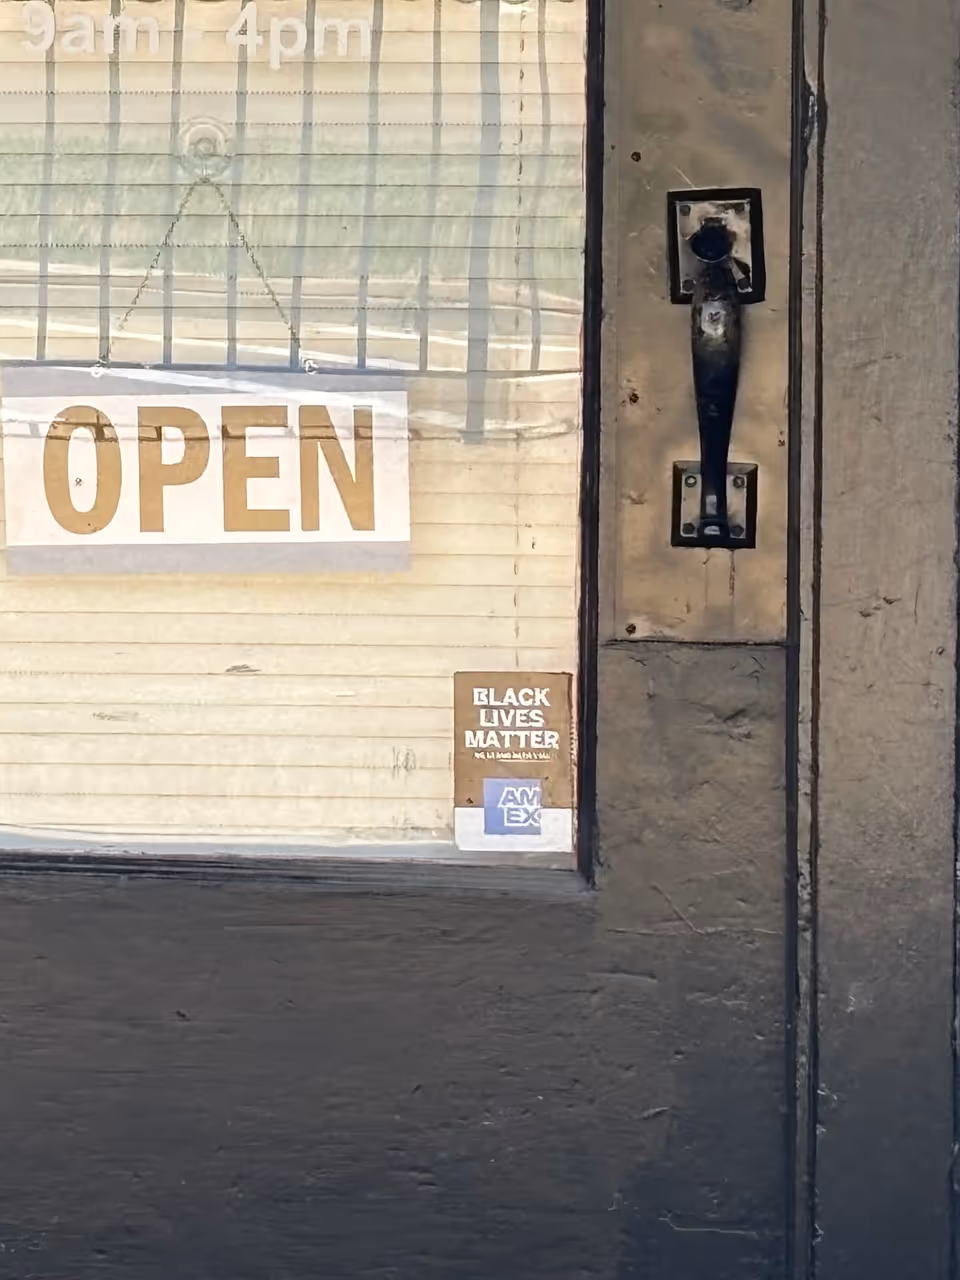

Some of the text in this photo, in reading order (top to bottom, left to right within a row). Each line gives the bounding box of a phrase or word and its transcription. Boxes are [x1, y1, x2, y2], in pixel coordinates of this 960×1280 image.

[23, 0, 160, 54] 9am
[226, 1, 371, 69] 4pm
[43, 405, 375, 535] OPEN
[473, 688, 551, 707] BLACK
[480, 709, 544, 727] LIVES
[465, 731, 559, 749] MATTER
